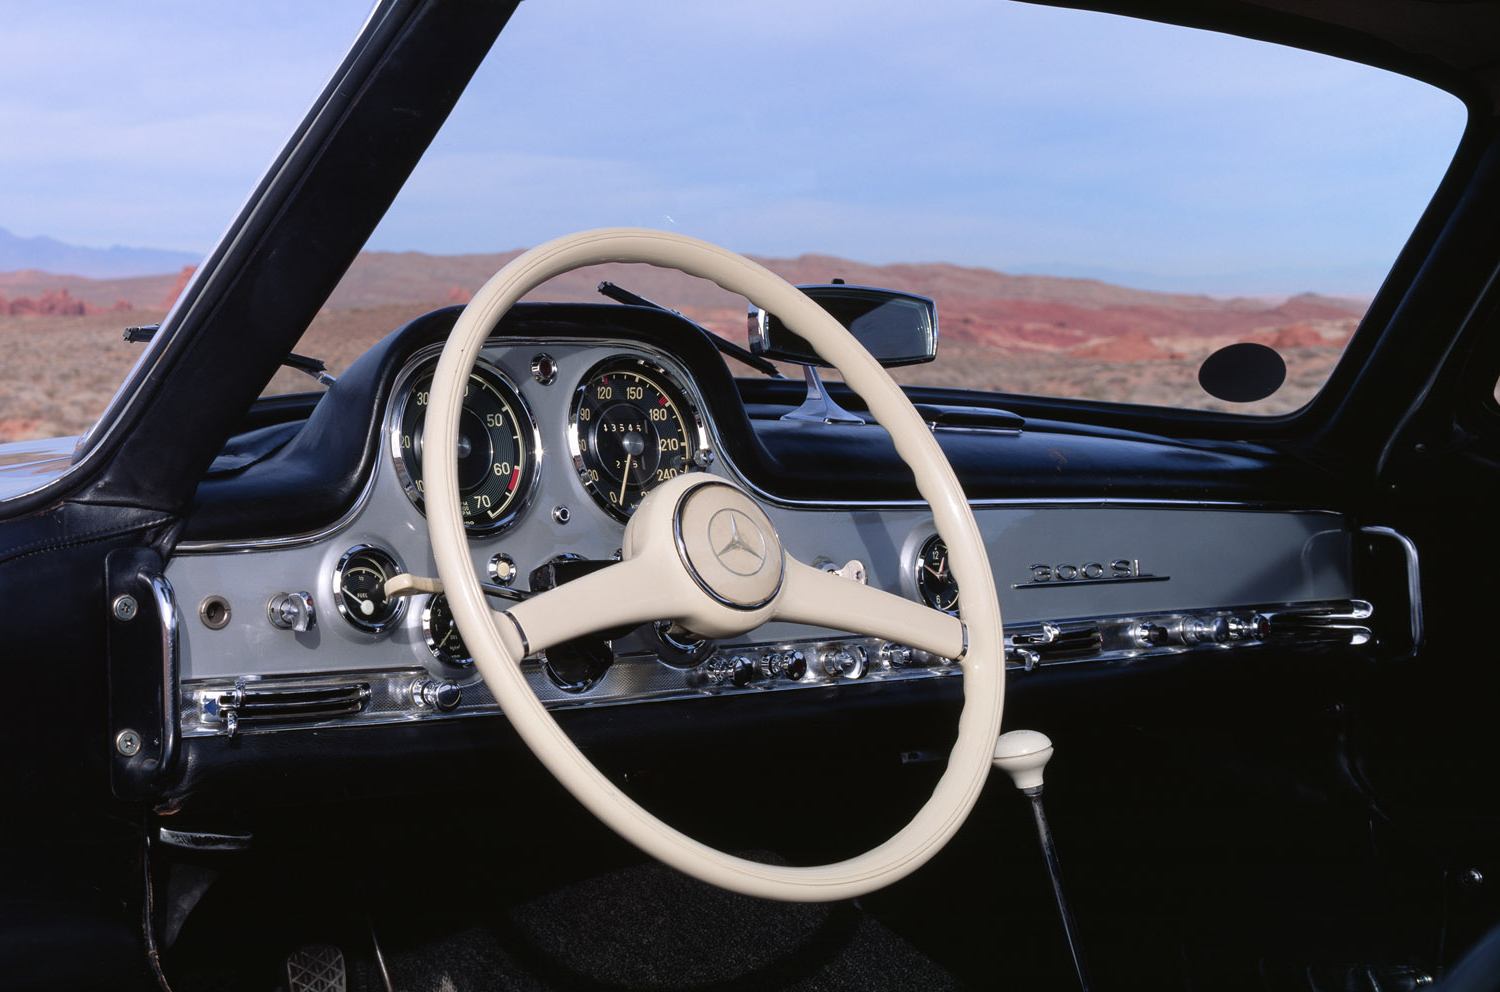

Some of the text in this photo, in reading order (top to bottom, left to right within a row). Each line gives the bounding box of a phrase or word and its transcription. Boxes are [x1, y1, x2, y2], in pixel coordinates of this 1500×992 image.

[597, 386, 612, 400] 120
[626, 386, 643, 400] 150
[487, 413, 502, 427] 50
[580, 408, 591, 421] 90
[649, 408, 667, 421] 180
[660, 438, 678, 451] 210
[493, 462, 510, 475] 60
[656, 468, 677, 482] 240
[473, 495, 491, 508] 70
[609, 491, 617, 503] 0
[932, 551, 939, 560] 12
[1028, 559, 1155, 582] 300 SL
[935, 595, 941, 604] 6
[436, 609, 442, 617] 2
